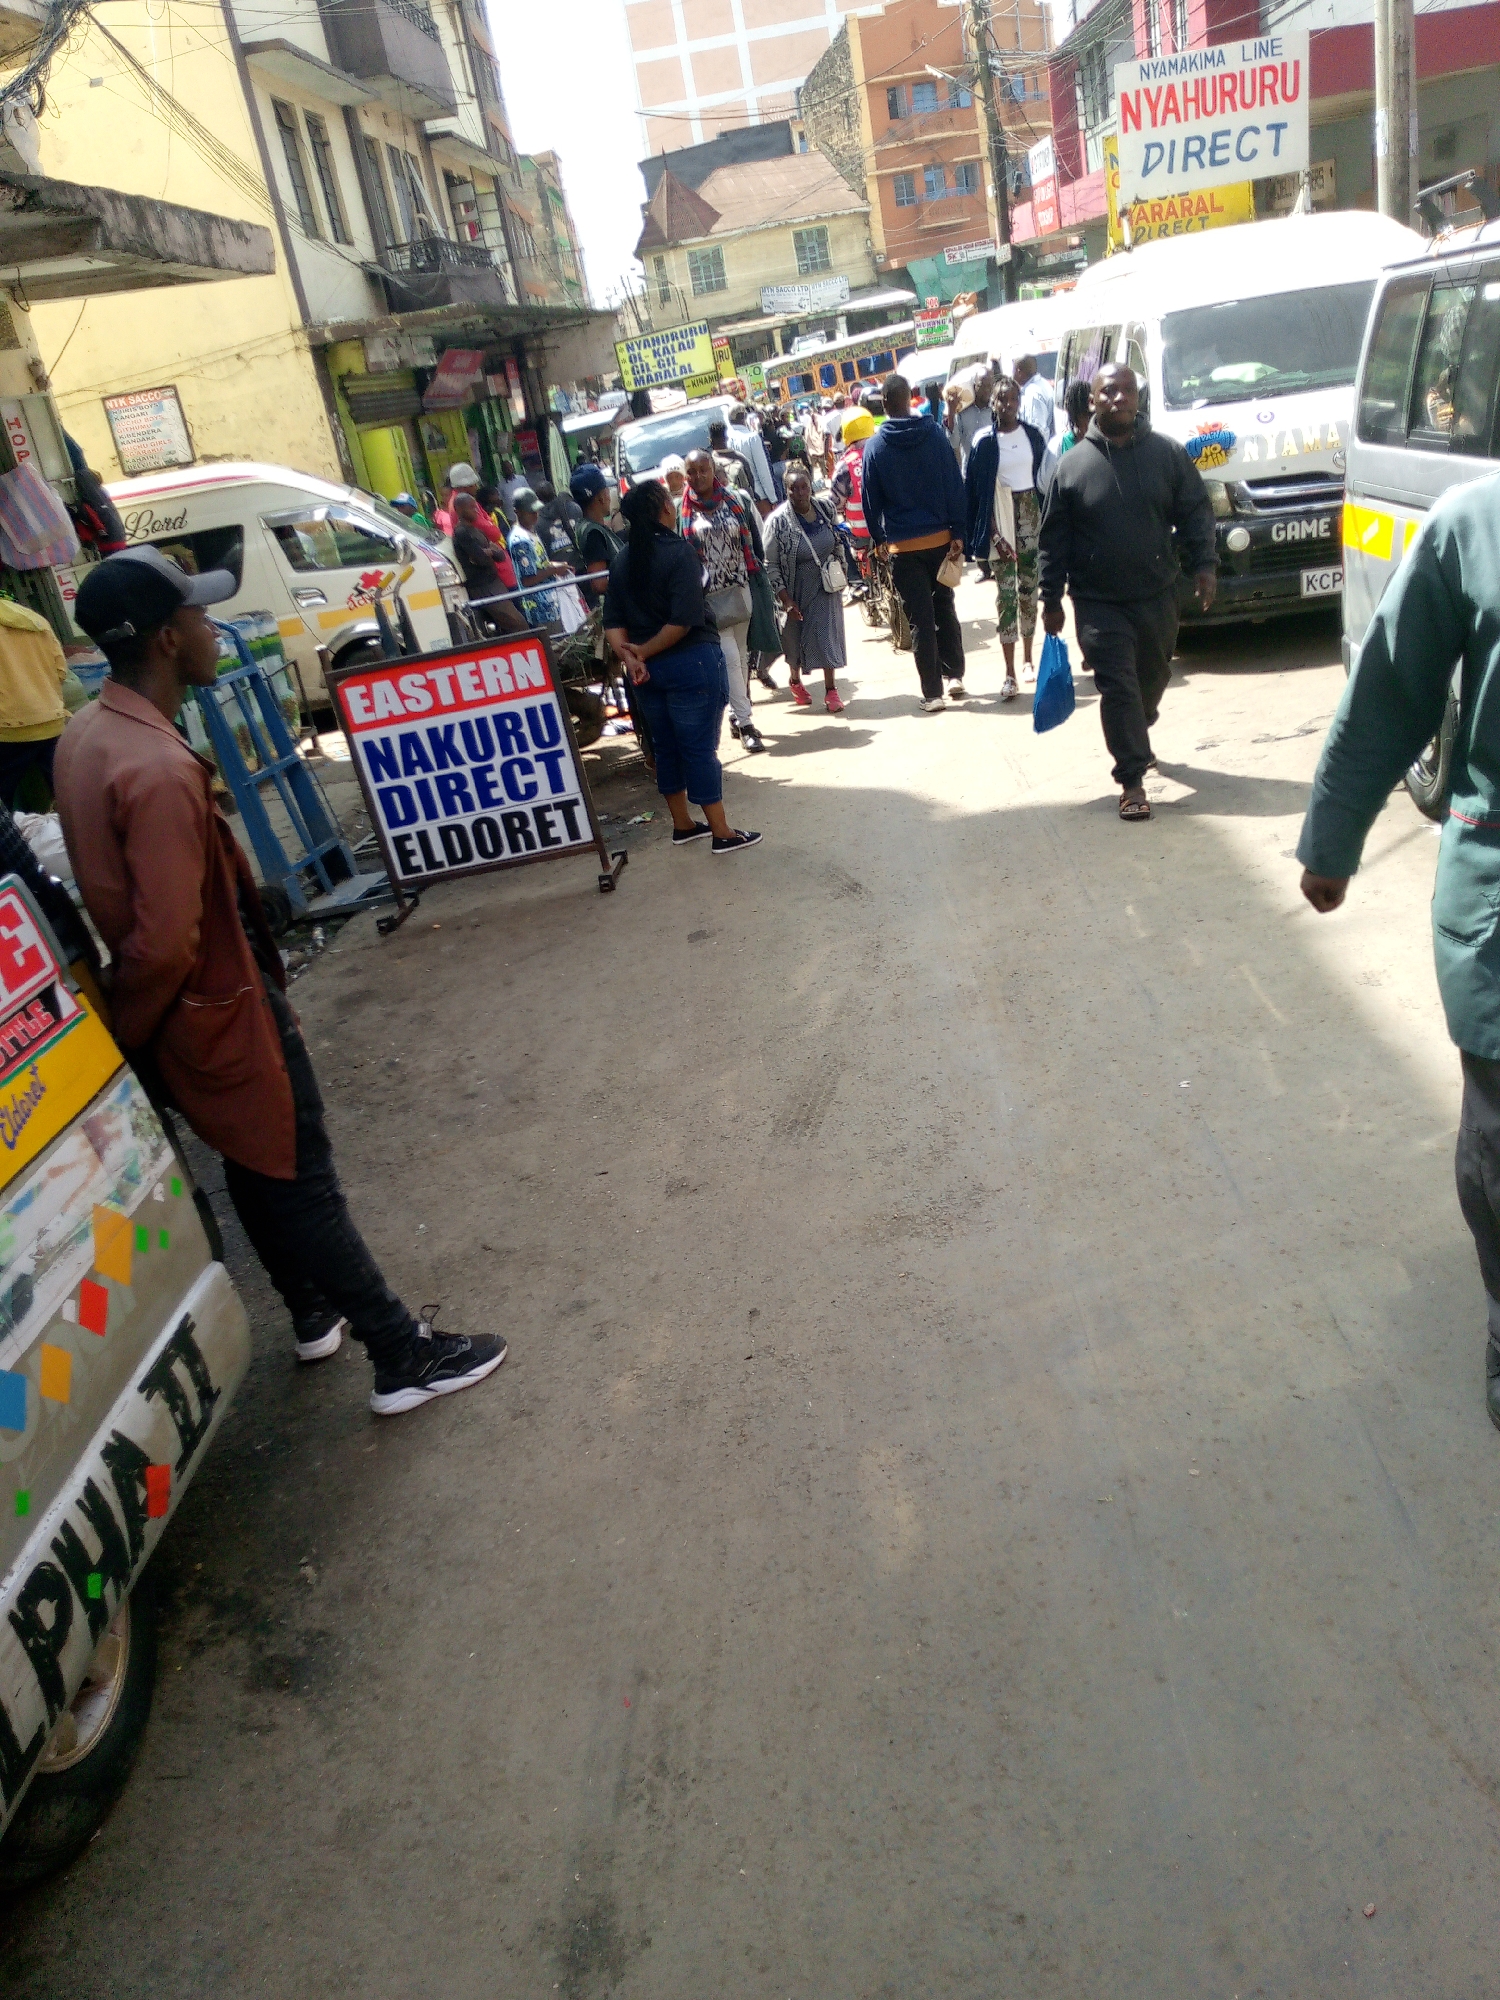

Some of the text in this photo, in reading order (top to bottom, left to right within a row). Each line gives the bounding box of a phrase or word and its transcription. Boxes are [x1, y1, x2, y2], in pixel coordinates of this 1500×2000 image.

[1139, 37, 1283, 81] NYAMAKIMA LINE
[1120, 59, 1300, 134] NYAHURURU
[1141, 121, 1288, 178] DIRECT
[1133, 215, 1210, 245] DIRECT
[625, 323, 708, 353] NYAHURURU
[633, 363, 694, 388] MARALAL
[105, 397, 126, 410] NTK
[128, 391, 162, 405] SACCO
[1201, 443, 1222, 457] NO
[124, 508, 188, 541] Lord
[1271, 517, 1331, 543] GAME
[344, 649, 546, 725] EASTERN
[362, 702, 562, 784] NAKURU
[377, 750, 566, 830] DIRECT
[391, 798, 582, 876] ELDORET
